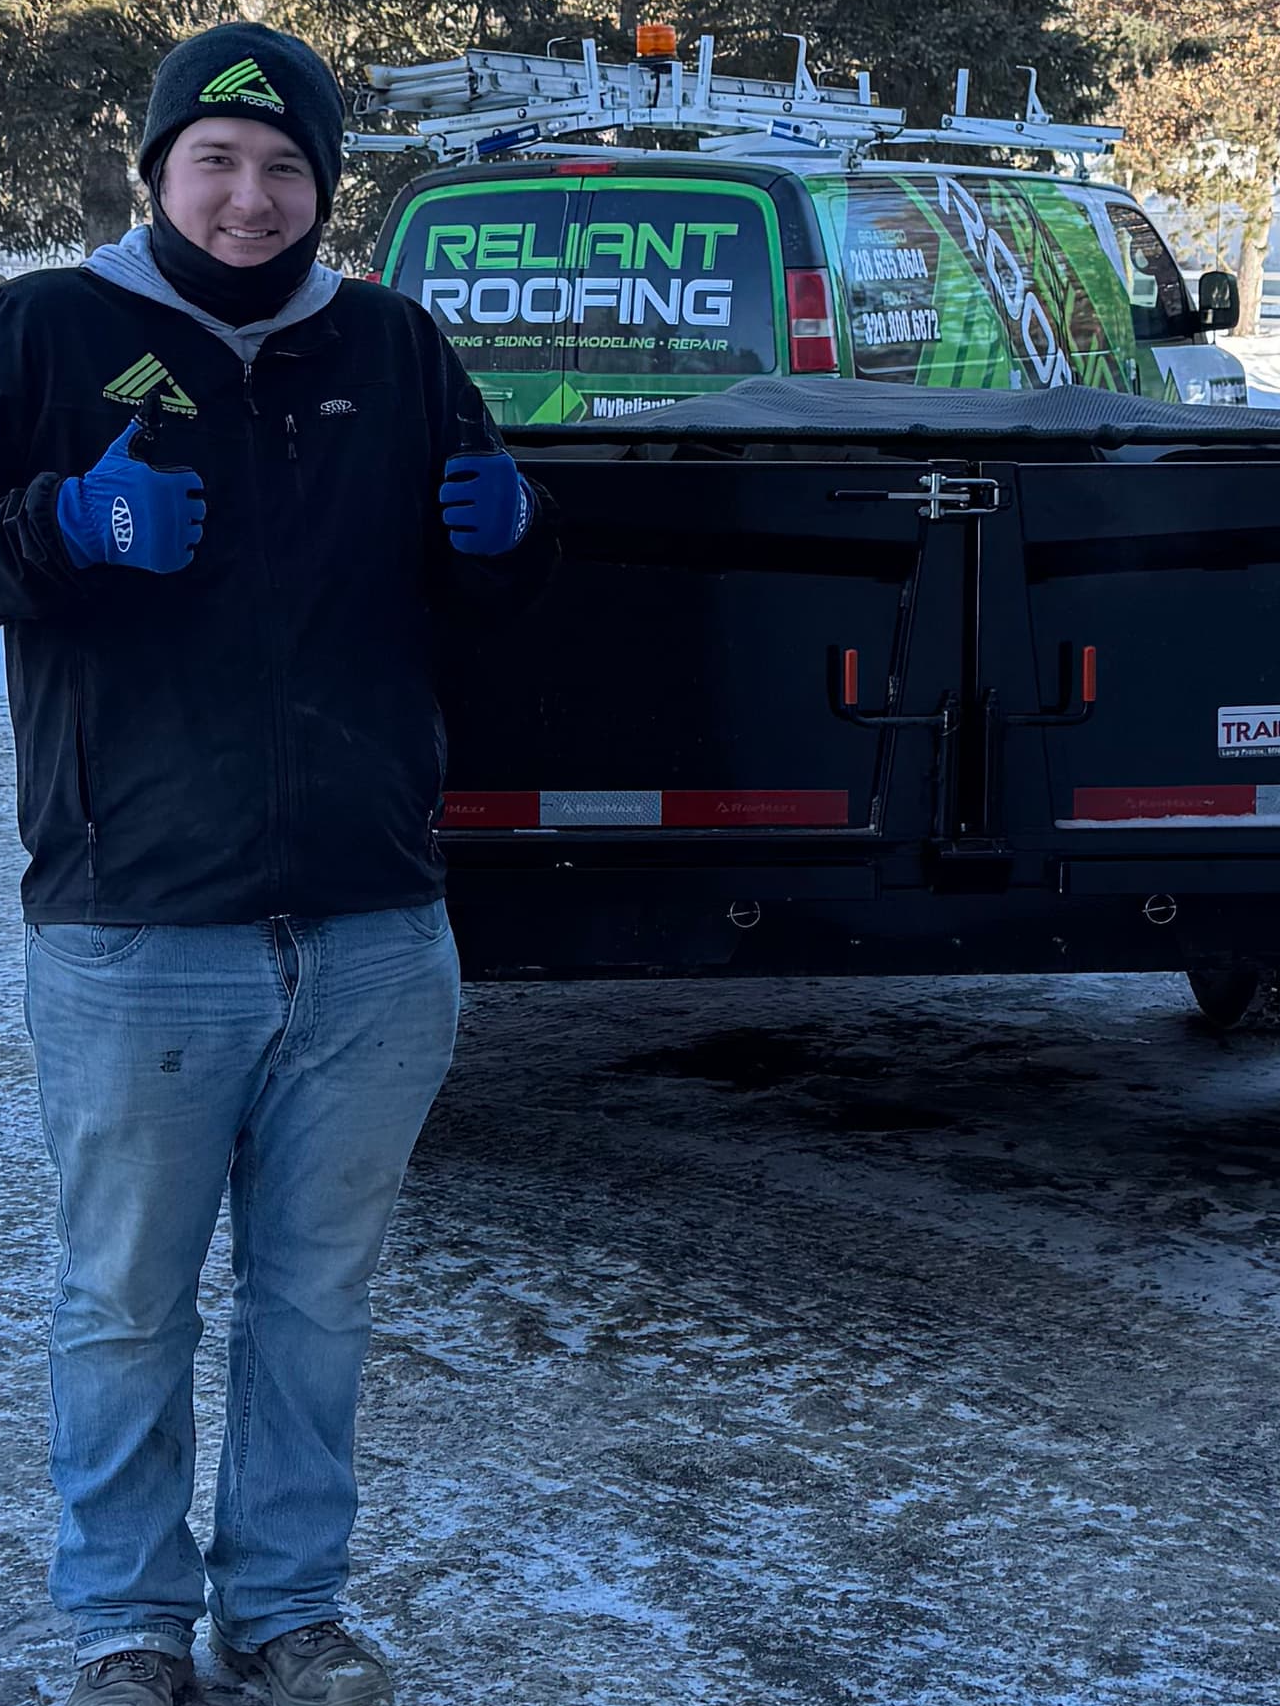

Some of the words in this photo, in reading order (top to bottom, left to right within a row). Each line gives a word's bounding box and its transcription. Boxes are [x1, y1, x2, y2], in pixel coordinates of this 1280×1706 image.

[424, 222, 739, 270] RELIANT
[420, 277, 733, 326] ROOFING
[448, 336, 483, 348] FING
[494, 336, 543, 348] SIDING
[554, 336, 656, 350] REMODELING
[667, 338, 728, 351] REPAIR
[862, 309, 941, 345] 320.800.6872
[112, 506, 132, 542] RW
